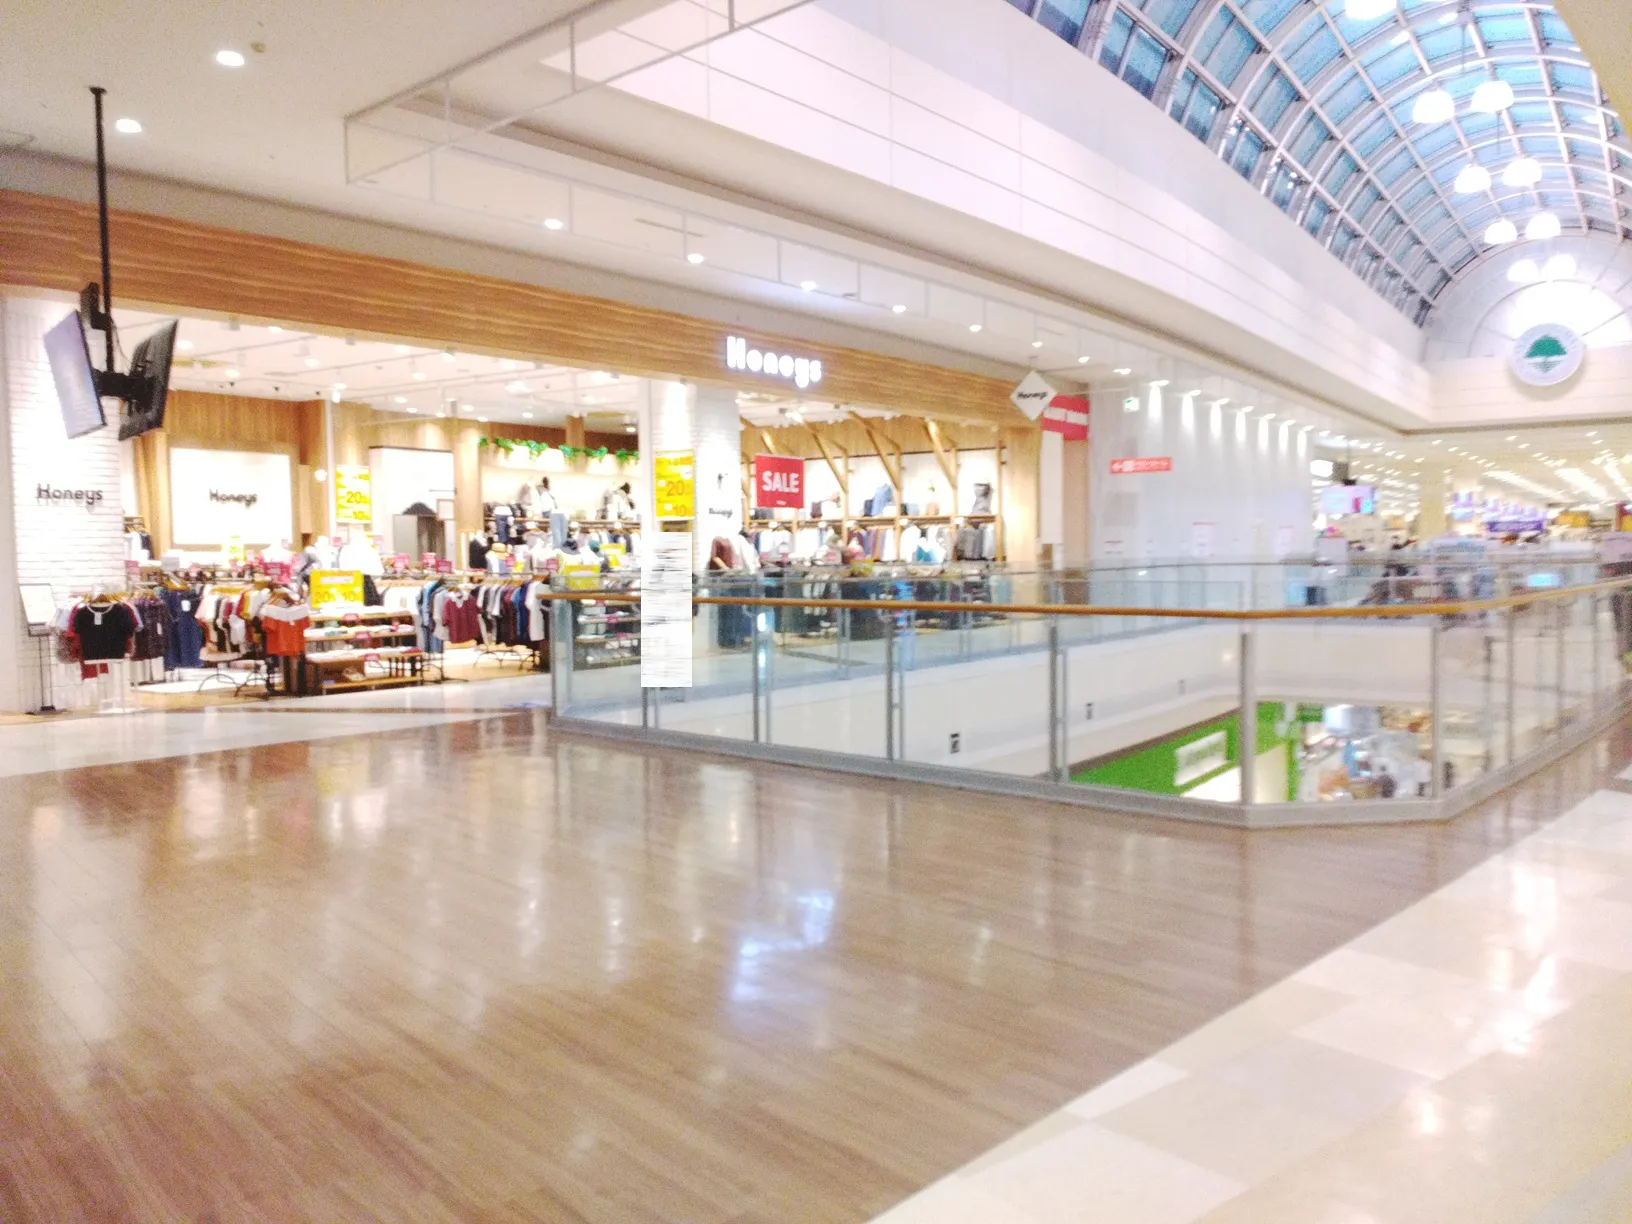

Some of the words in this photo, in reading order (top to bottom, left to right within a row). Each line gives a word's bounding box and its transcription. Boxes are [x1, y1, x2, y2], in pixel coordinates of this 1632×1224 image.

[727, 336, 822, 388] Honeys
[762, 471, 800, 493] SALE
[37, 483, 103, 506] Honeys
[209, 487, 258, 510] Honeys
